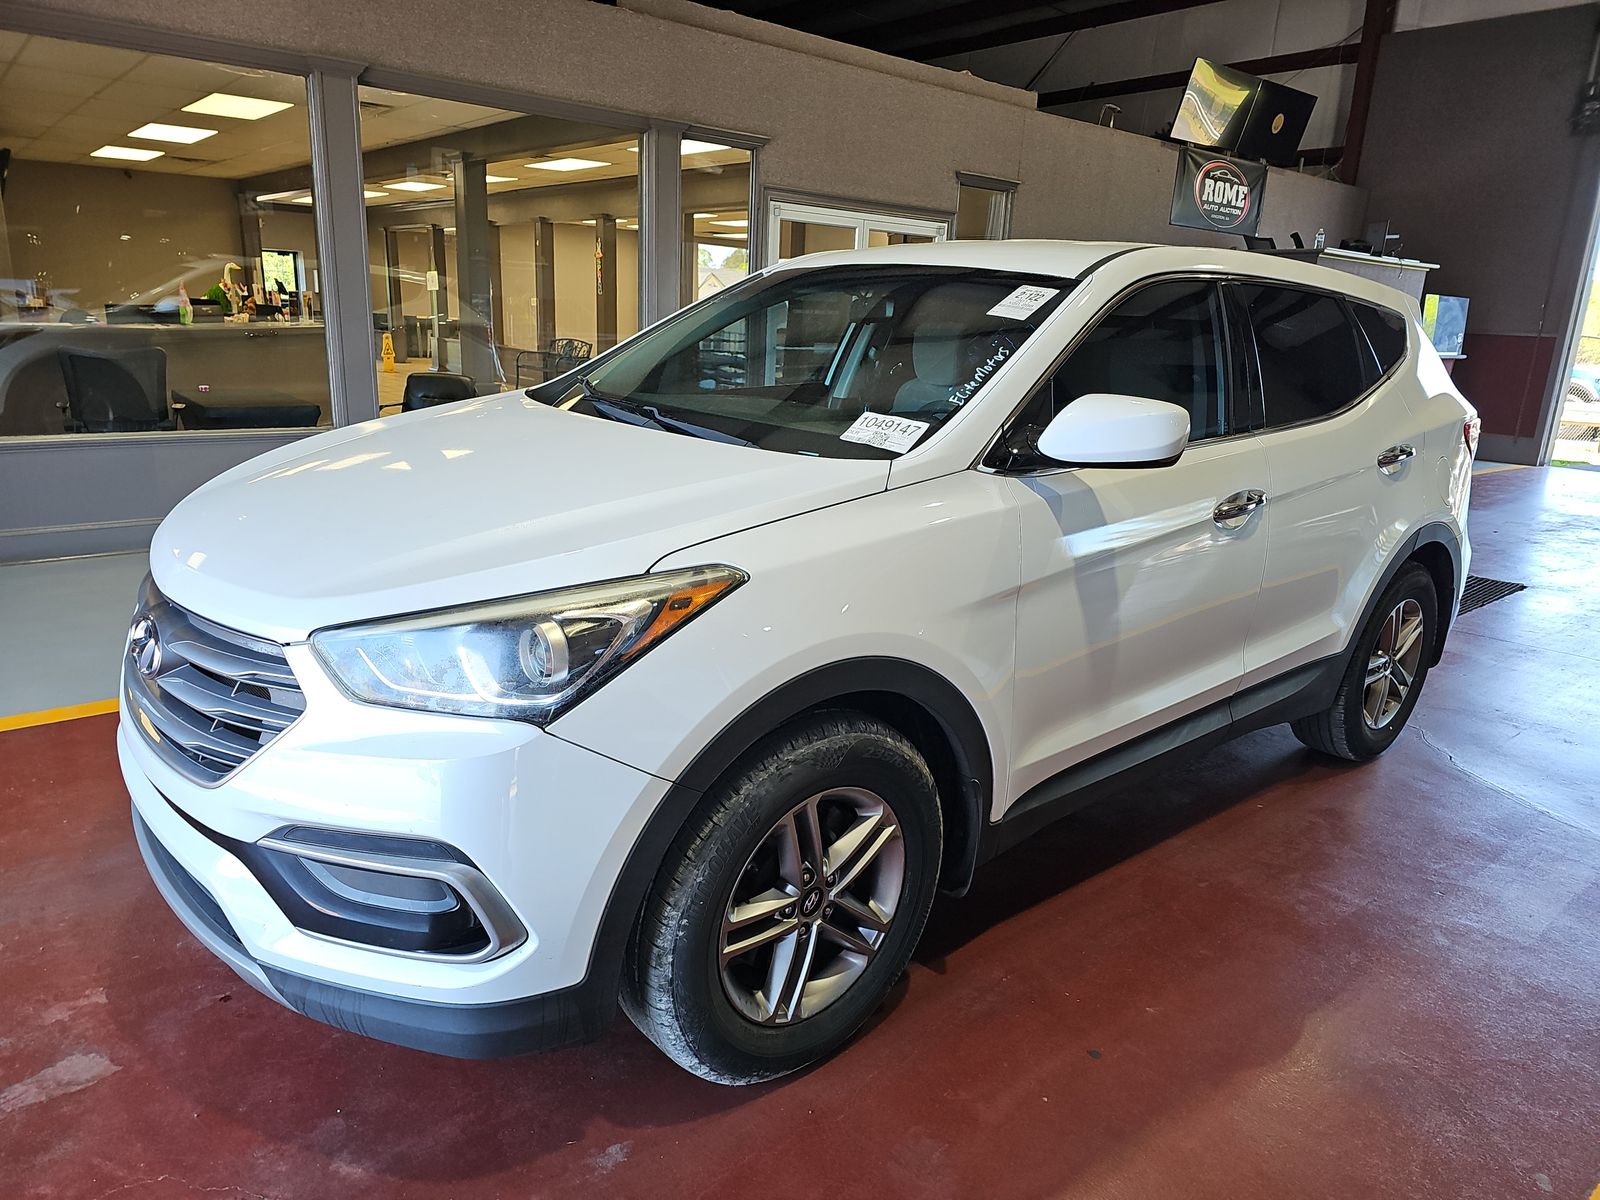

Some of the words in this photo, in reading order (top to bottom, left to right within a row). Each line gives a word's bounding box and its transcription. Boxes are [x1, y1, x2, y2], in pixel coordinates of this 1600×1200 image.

[1202, 178, 1248, 208] ROME
[1219, 206, 1242, 215] AUCTION
[860, 416, 922, 436] 1049147
